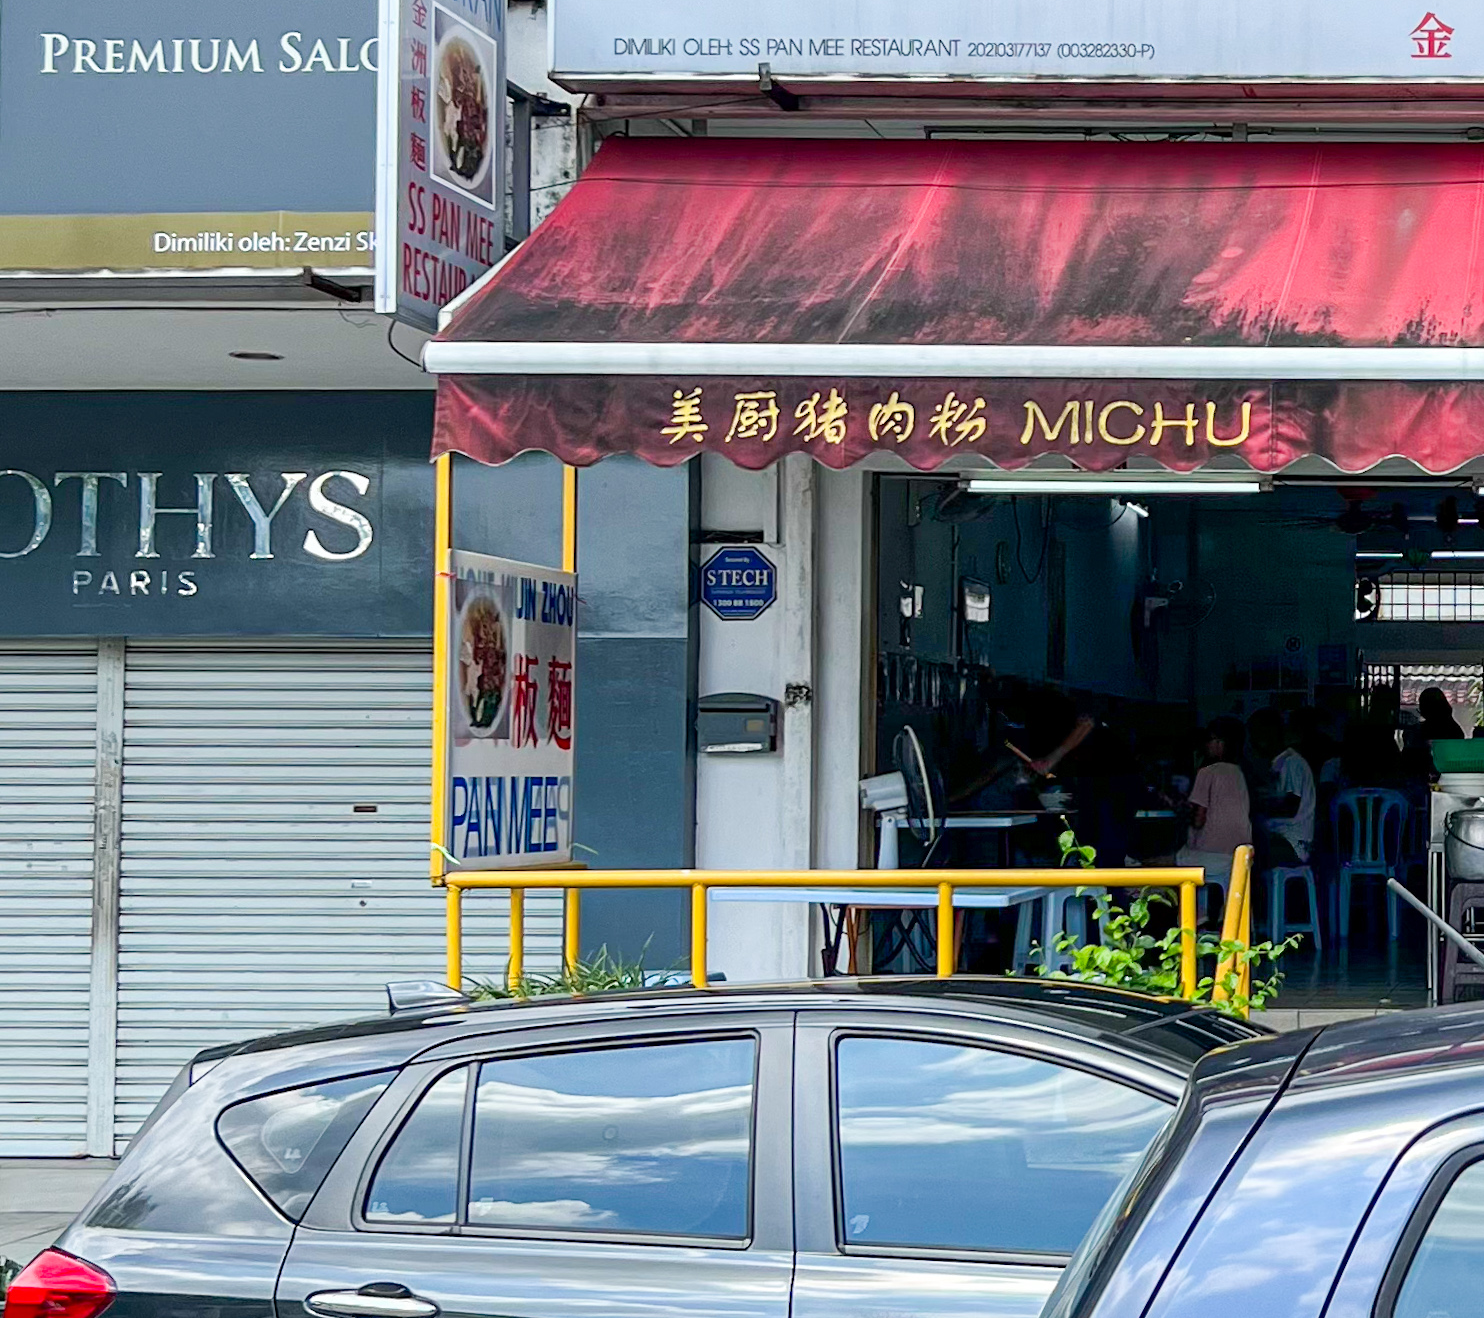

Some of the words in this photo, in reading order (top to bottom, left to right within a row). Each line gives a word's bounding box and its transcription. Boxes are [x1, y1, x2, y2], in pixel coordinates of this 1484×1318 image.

[41, 34, 264, 73] PREMIUM
[614, 37, 676, 56] DIMILIKI
[683, 37, 733, 56] OLEH:
[739, 37, 761, 56] SS
[766, 37, 803, 56] PAN
[809, 37, 845, 56] MEE
[851, 37, 961, 57] RESTAURANT
[154, 232, 233, 252] Dimiliki
[238, 232, 291, 252] oleh:
[293, 232, 351, 252] Zenzi
[408, 181, 426, 235] SS
[431, 192, 461, 252] PAN
[465, 209, 495, 267] MEE
[1021, 400, 1251, 447] MICHU
[72, 570, 199, 596] PARIS
[541, 581, 575, 627] ZHOU
[452, 775, 501, 859] PAN
[508, 775, 559, 855] MEE
